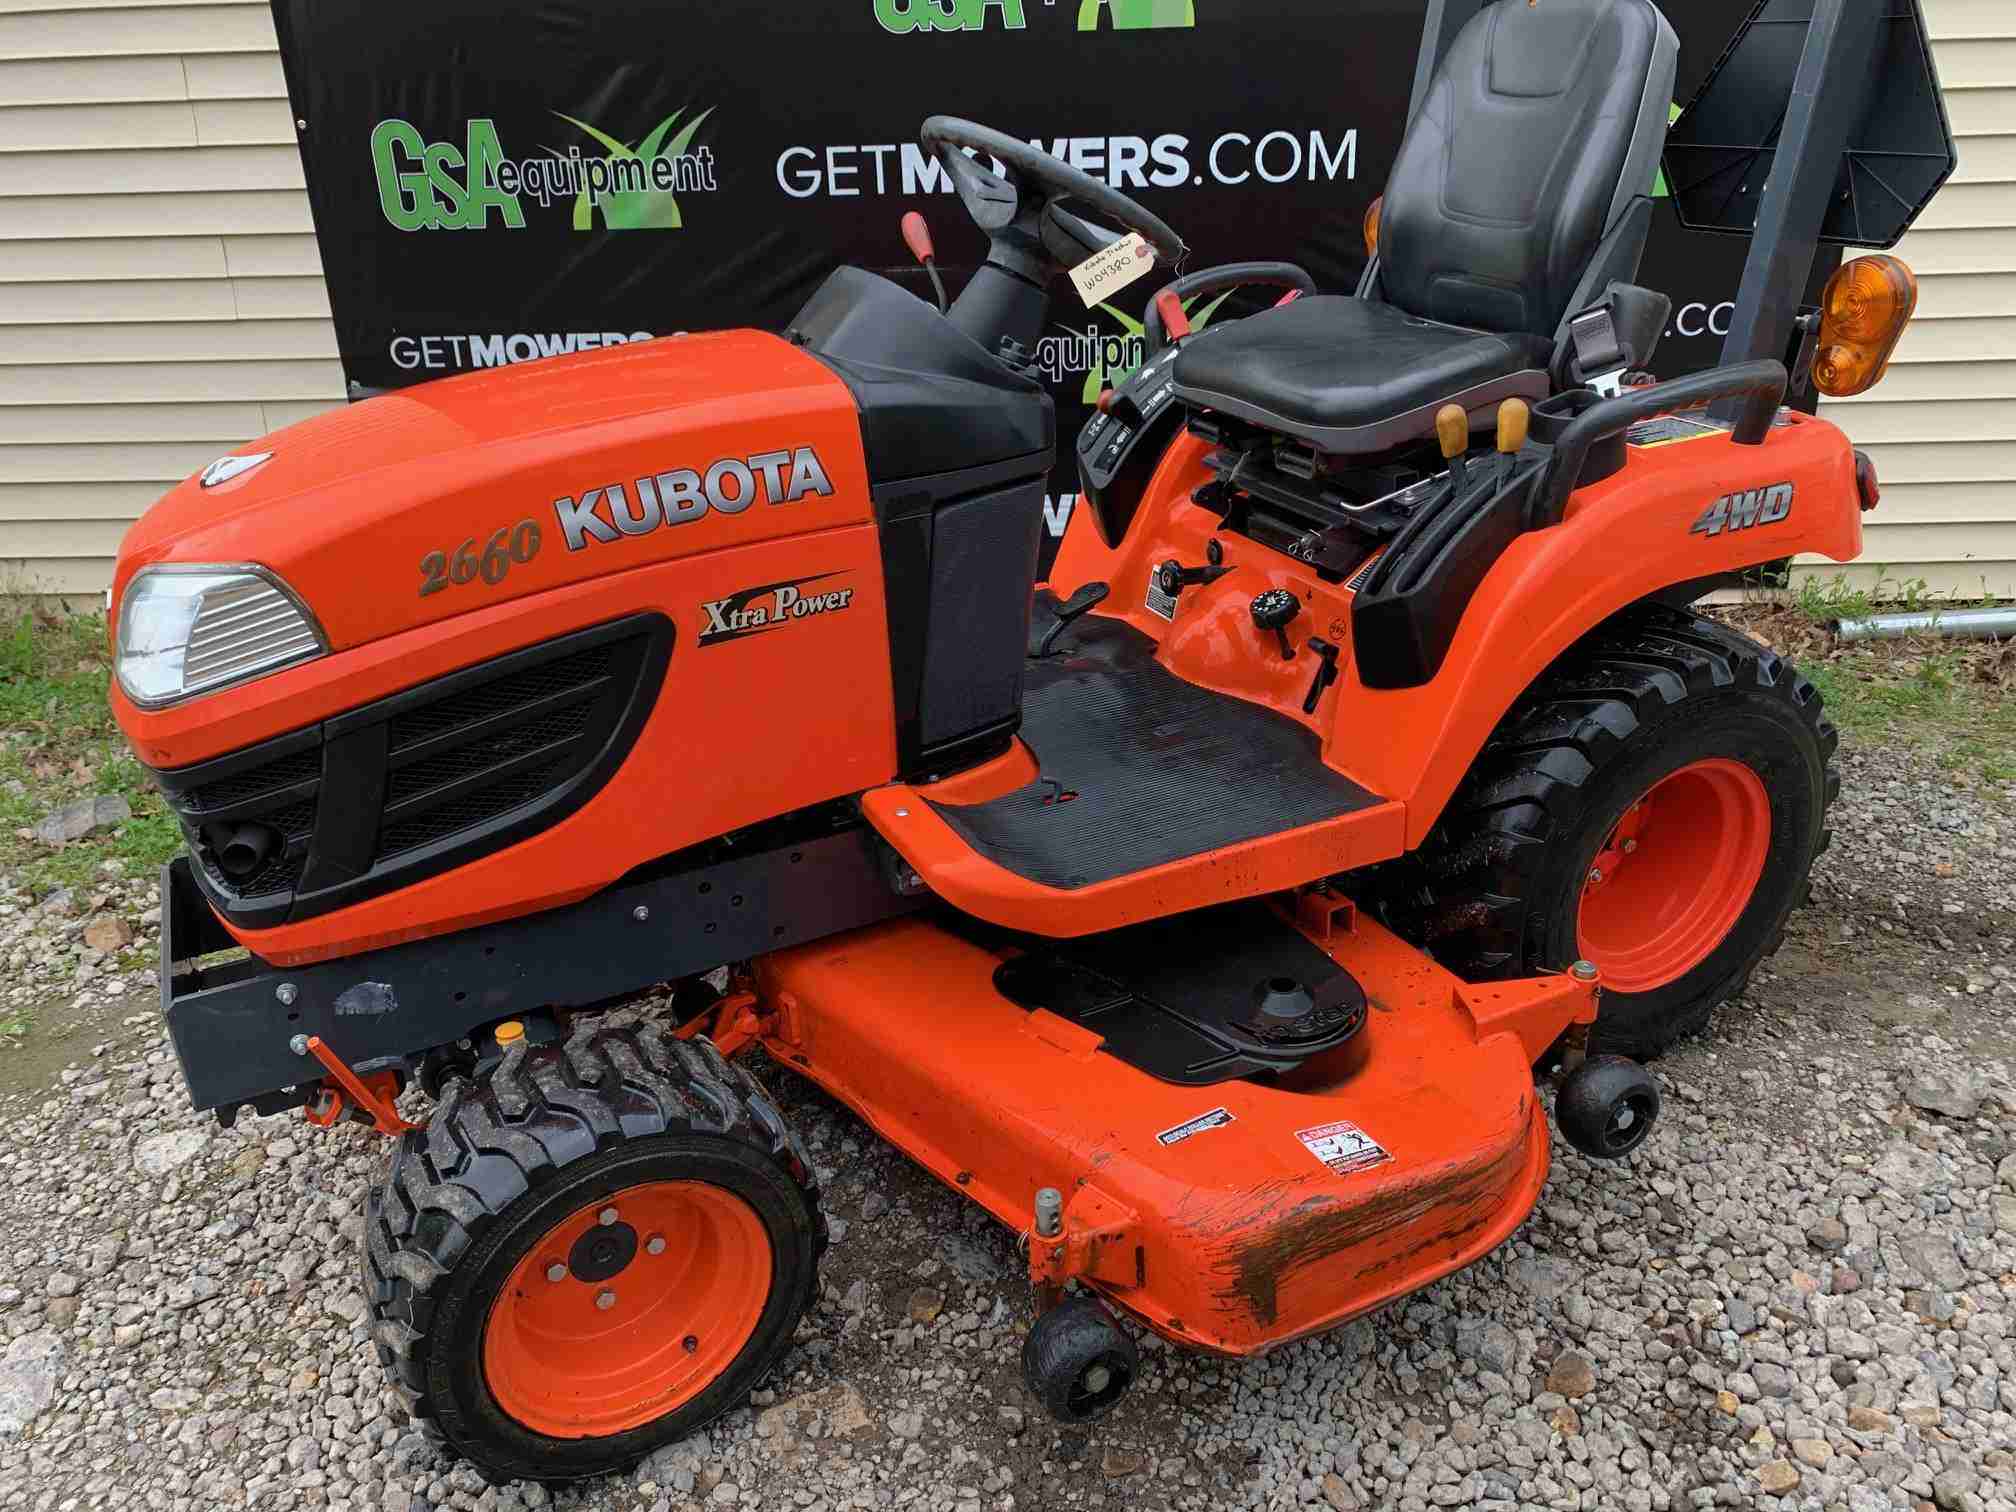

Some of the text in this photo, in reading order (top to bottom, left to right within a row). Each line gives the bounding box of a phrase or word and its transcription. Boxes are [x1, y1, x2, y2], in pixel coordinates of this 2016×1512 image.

[496, 146, 716, 207] equipment
[776, 129, 1357, 197] GETMERS.COM
[554, 446, 834, 552] KUBOTA
[1688, 481, 1794, 538] 4WD
[418, 518, 542, 598] 2660
[700, 583, 853, 640] Xtra Power
